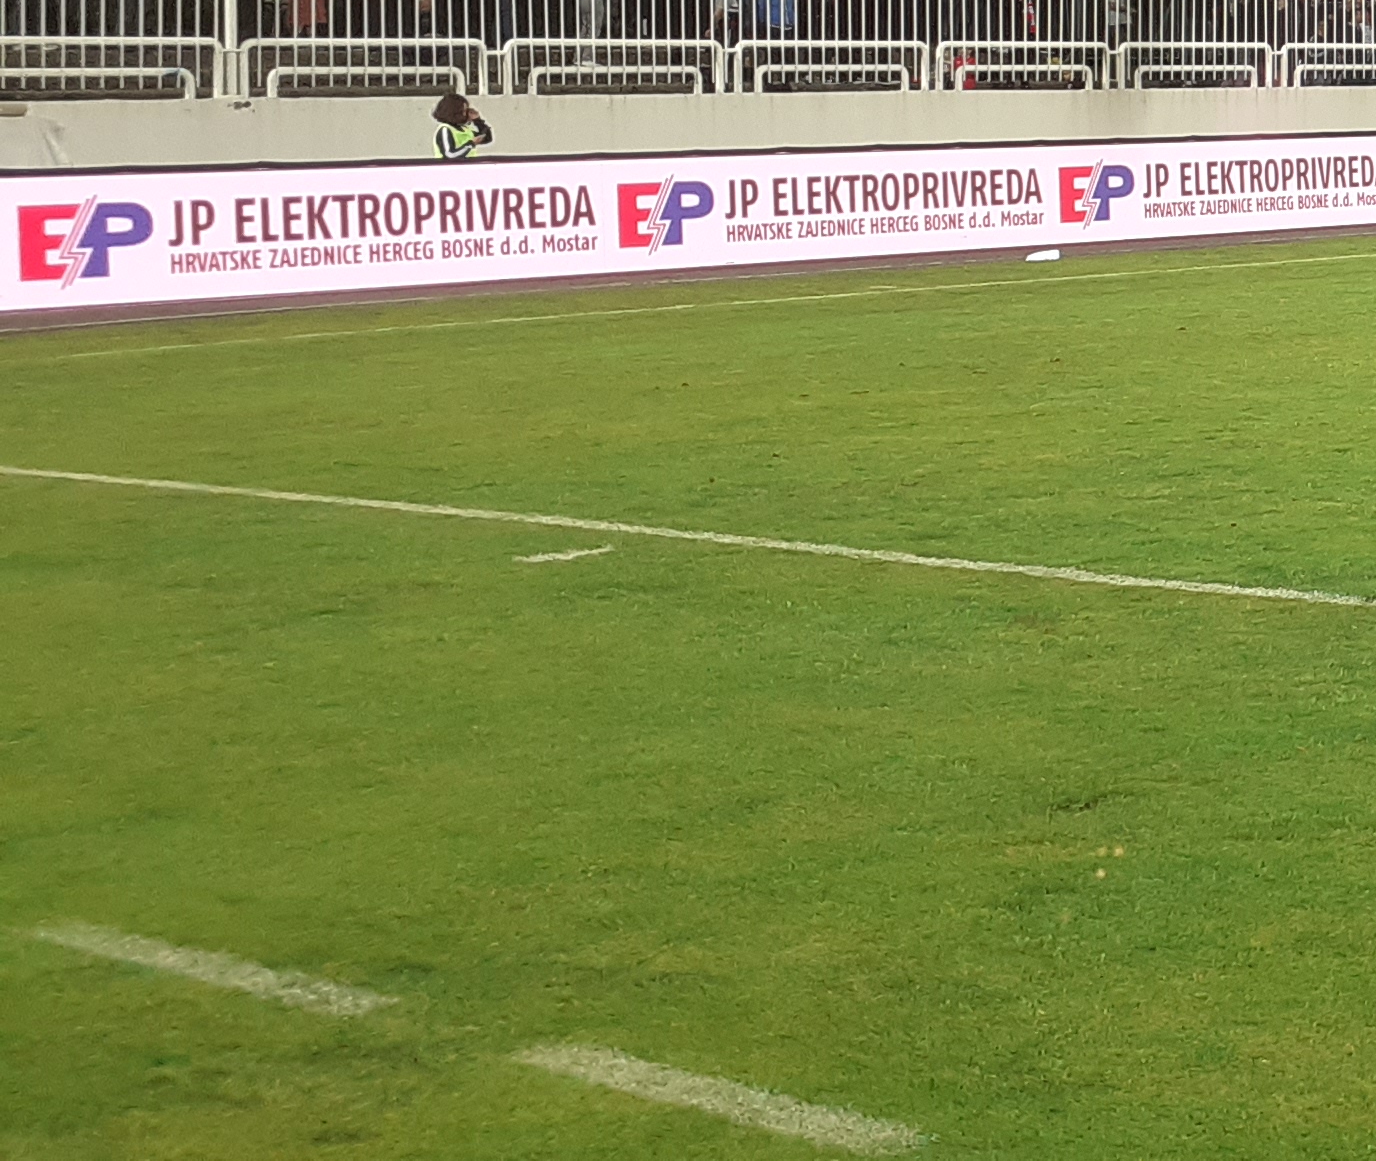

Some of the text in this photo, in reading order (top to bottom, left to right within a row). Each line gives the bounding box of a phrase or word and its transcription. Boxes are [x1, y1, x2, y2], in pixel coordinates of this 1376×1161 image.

[725, 168, 1043, 219] JP ELEKTROPRIVREDA
[1058, 165, 1135, 224] EP
[1143, 163, 1170, 199] JP
[1144, 200, 1196, 219] HRVATSKE
[1199, 197, 1253, 216] ZAJEDNICE
[1256, 195, 1294, 213] HERCEG
[1297, 193, 1329, 210] BOSNE
[1332, 192, 1353, 208] d.d.
[168, 185, 596, 247] JP ELEKTROPRIVREDA
[617, 180, 714, 248] EP
[726, 210, 1045, 243] HRVATSKE ZAJEDNICE HERCEG BOSNE d.d. Mostar
[17, 201, 154, 282] EP
[170, 233, 599, 274] HRVATSKE ZAJEDNICE HERCEG BOSNE d.d. Mostar
